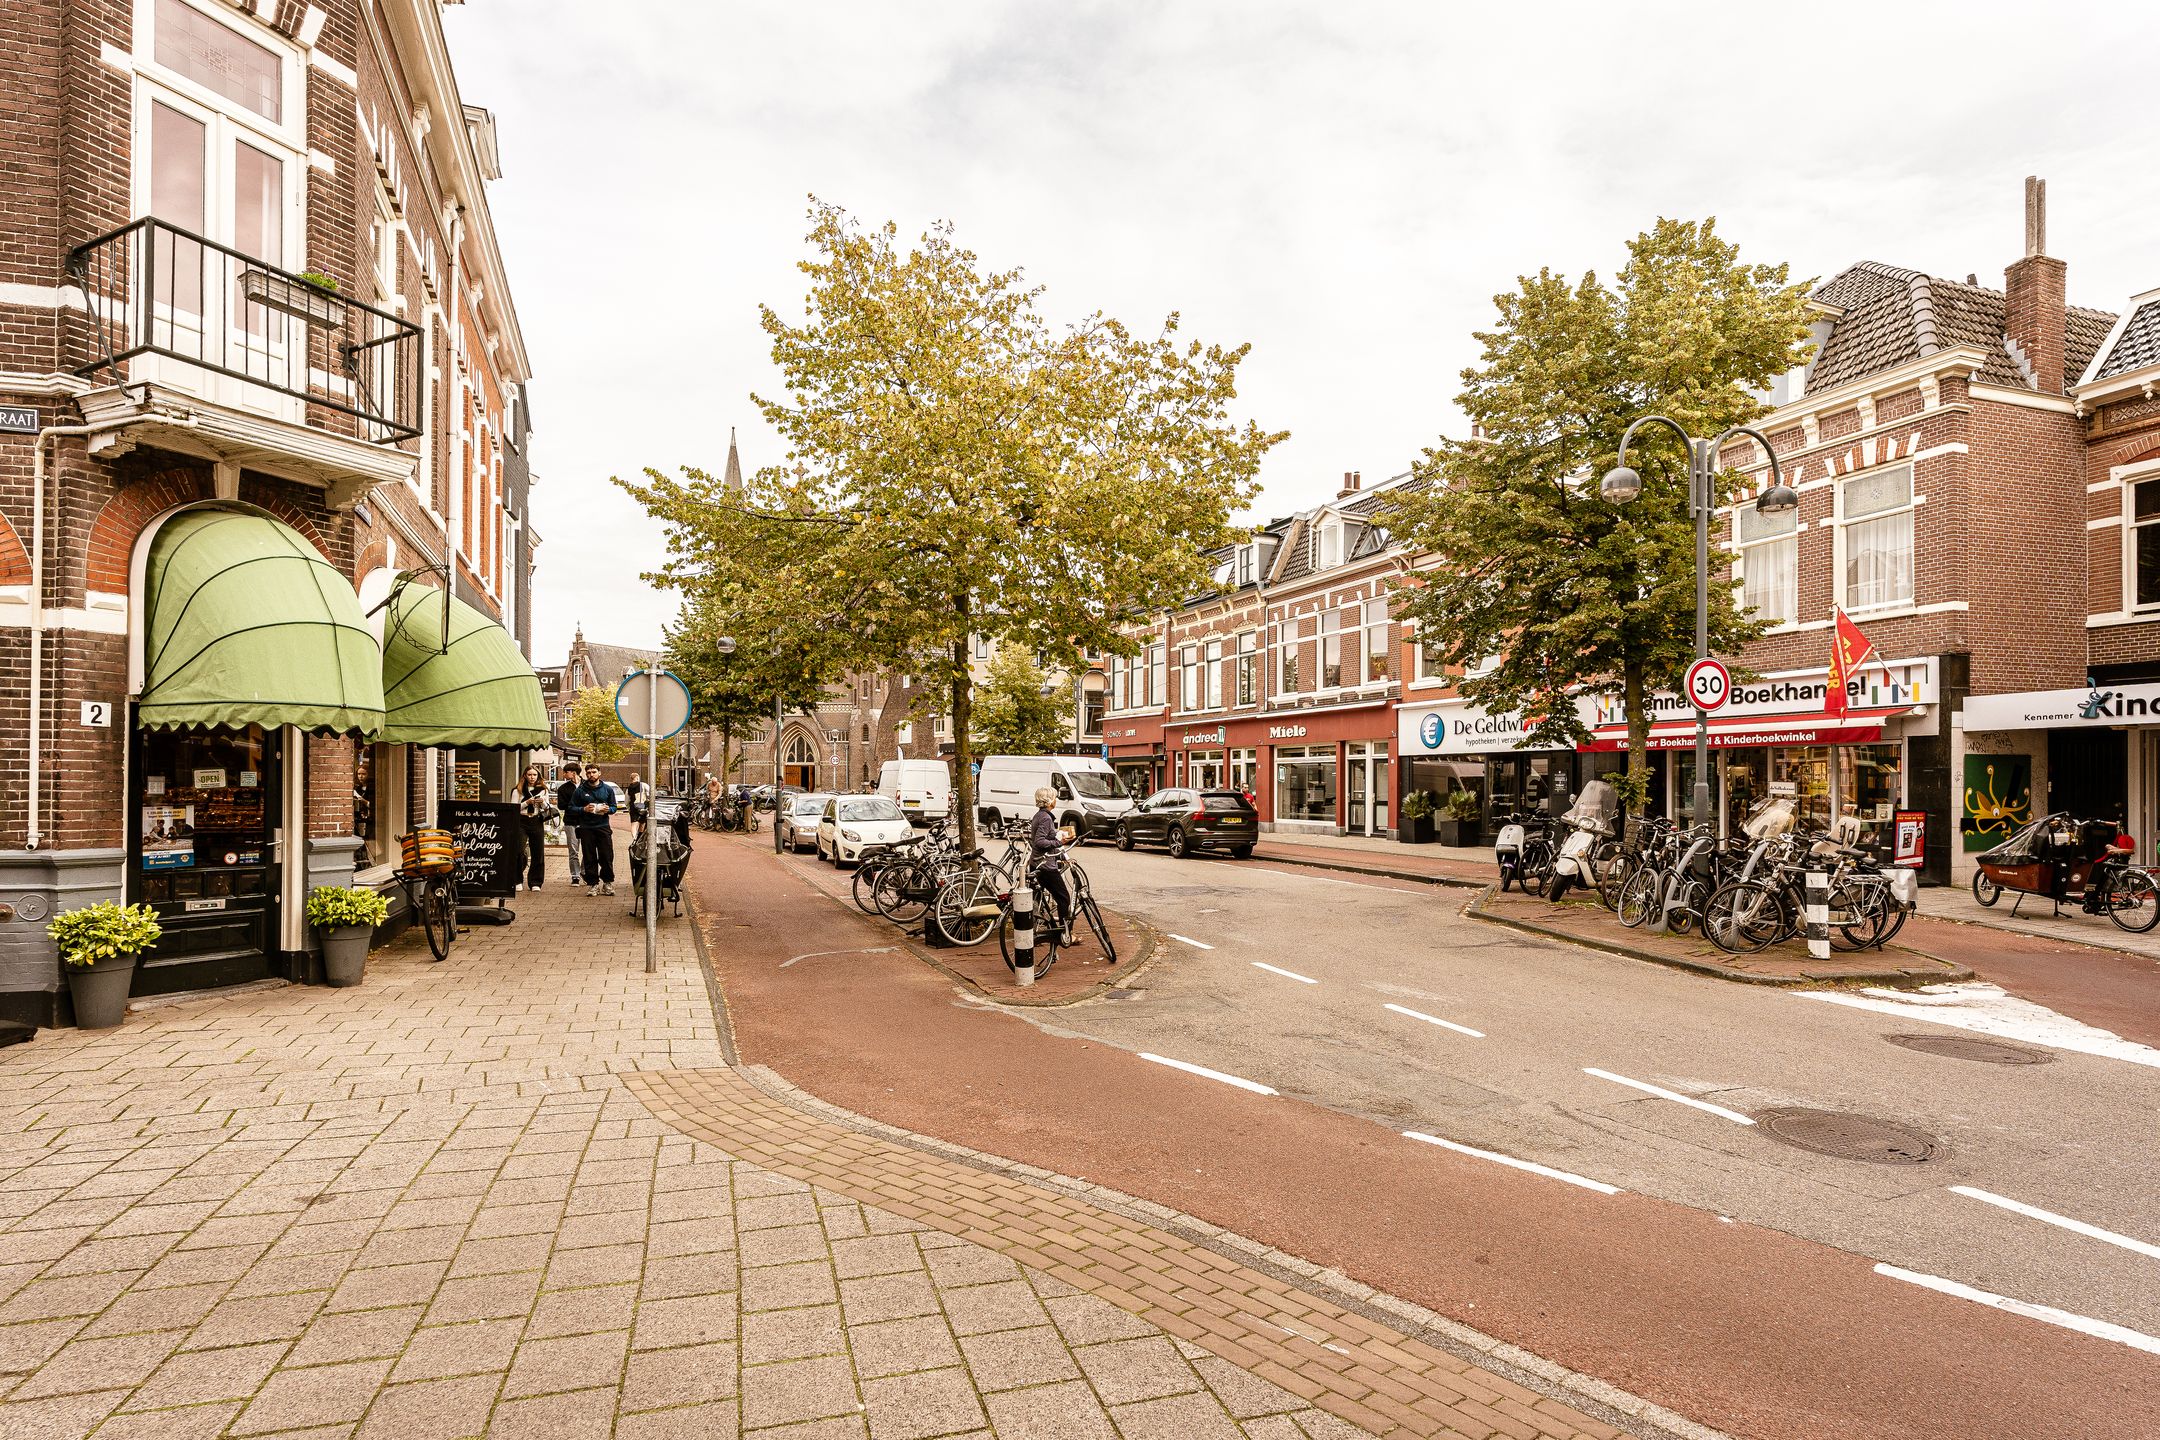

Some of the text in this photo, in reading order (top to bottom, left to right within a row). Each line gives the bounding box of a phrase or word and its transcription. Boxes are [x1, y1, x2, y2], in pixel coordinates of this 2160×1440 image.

[0, 412, 34, 426] RAAT
[1696, 676, 1723, 695] 30
[1730, 676, 1866, 705] Boekhanel
[90, 704, 103, 724] 2
[2024, 712, 2074, 721] Kennemer
[1269, 725, 1307, 739] Miele
[1454, 720, 1472, 735] De
[1465, 738, 1497, 747] hypotheken
[1714, 736, 1721, 745] &
[1723, 731, 1816, 745] Kinderboekwinkel
[200, 775, 220, 783] OPEN
